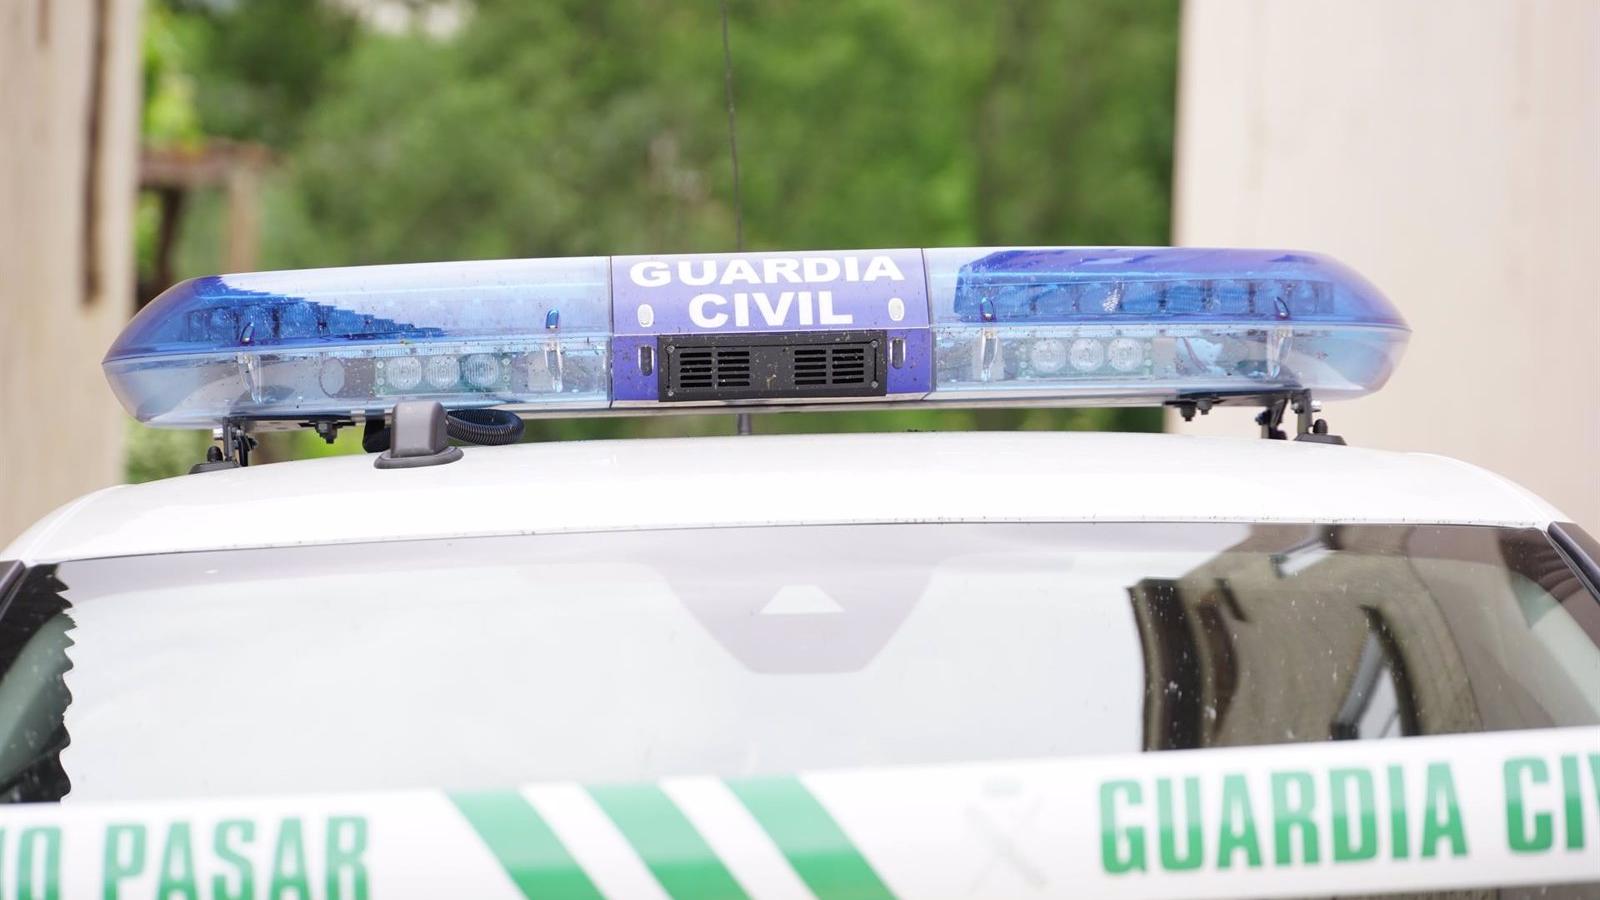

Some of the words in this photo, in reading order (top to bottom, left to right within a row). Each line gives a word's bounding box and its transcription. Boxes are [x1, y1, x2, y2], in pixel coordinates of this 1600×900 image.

[629, 255, 905, 287] GUARDIA
[688, 291, 854, 328] CIVIL
[1099, 762, 1469, 876] GUARDIA
[1503, 752, 1600, 854] CI
[0, 825, 62, 900] O
[101, 816, 370, 900] PASAR
